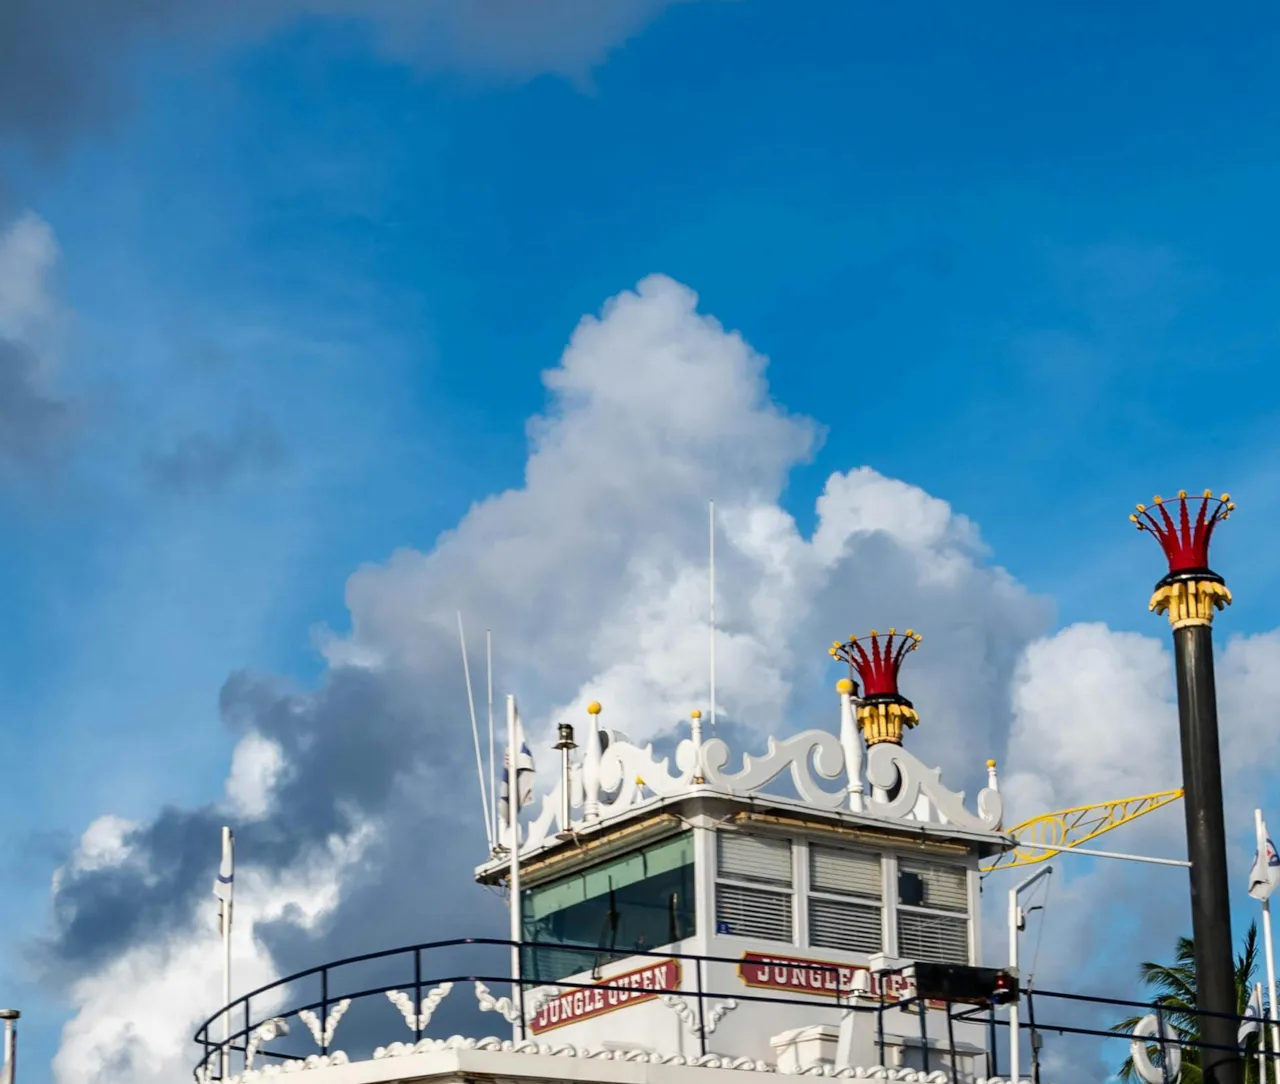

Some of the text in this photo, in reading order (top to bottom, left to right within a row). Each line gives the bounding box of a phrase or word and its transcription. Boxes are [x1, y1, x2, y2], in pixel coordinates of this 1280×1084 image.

[539, 965, 667, 1027] JUNGLE QUEEN
[757, 958, 852, 991] JUNGLE
